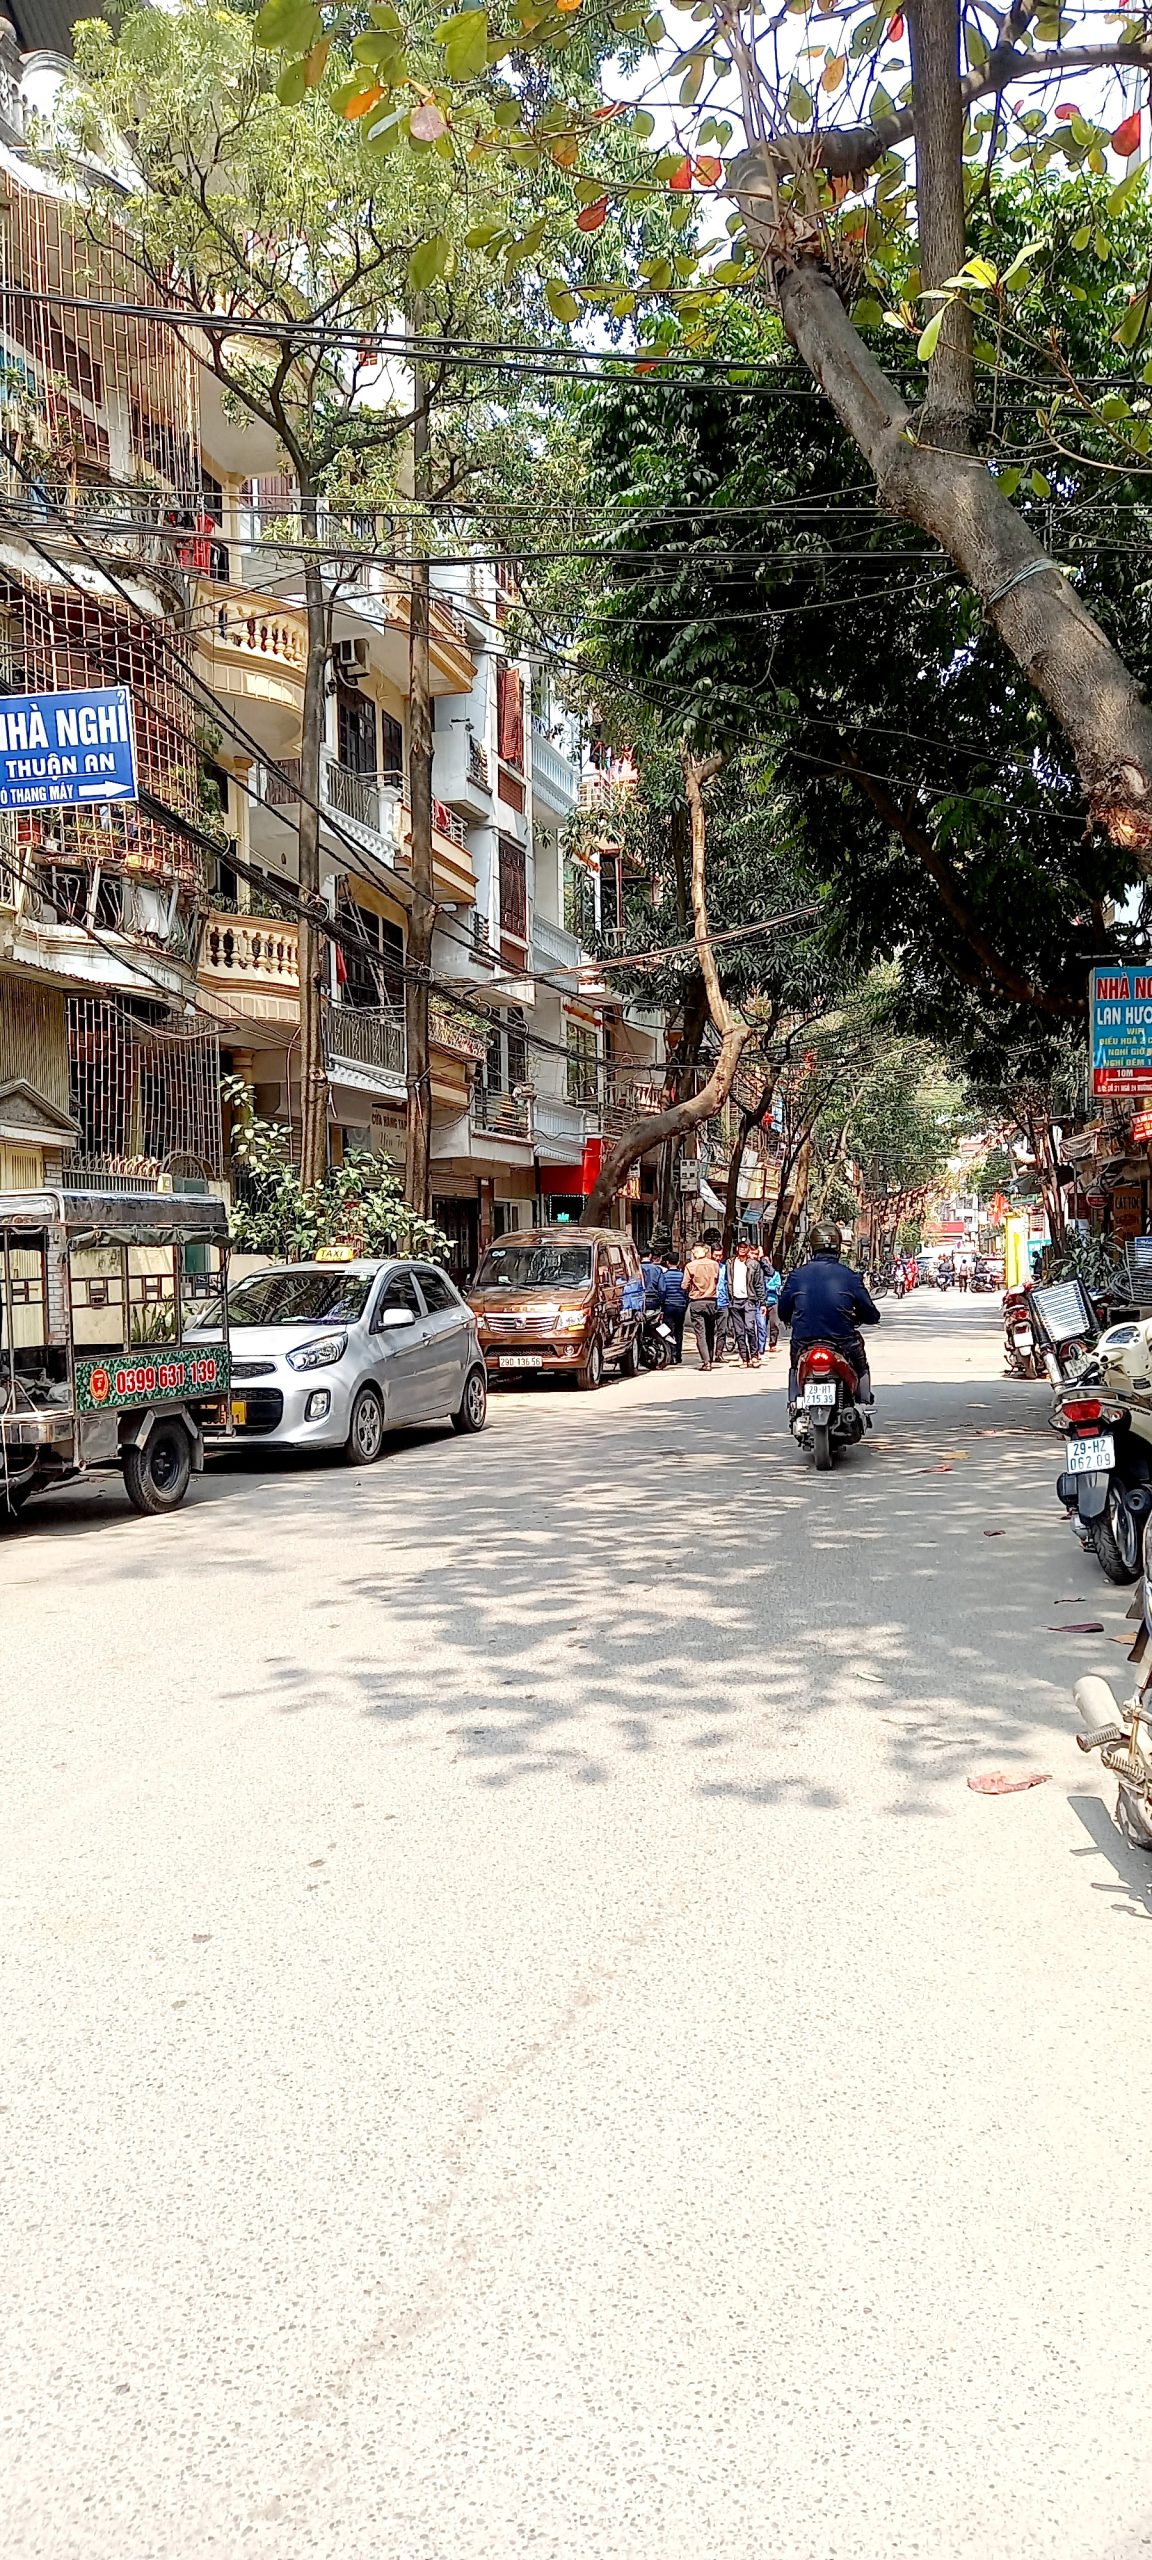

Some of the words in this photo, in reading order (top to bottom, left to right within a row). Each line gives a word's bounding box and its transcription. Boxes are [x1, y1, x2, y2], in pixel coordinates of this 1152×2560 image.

[55, 690, 128, 747] NGHỈ
[5, 752, 77, 781] THUẬN
[84, 753, 115, 772] AN
[10, 786, 47, 803] THANG
[49, 781, 73, 800] MÁY
[1096, 972, 1130, 1000] NHÀ
[1097, 1007, 1121, 1025] LAN
[1117, 1069, 1133, 1077] 10M
[320, 1249, 343, 1257] TAXI
[116, 1366, 155, 1395] 0399
[158, 1362, 184, 1389] 631
[190, 1359, 216, 1384] 139
[1073, 1439, 1106, 1456] 29-H2
[1070, 1453, 1111, 1471] 062.09
